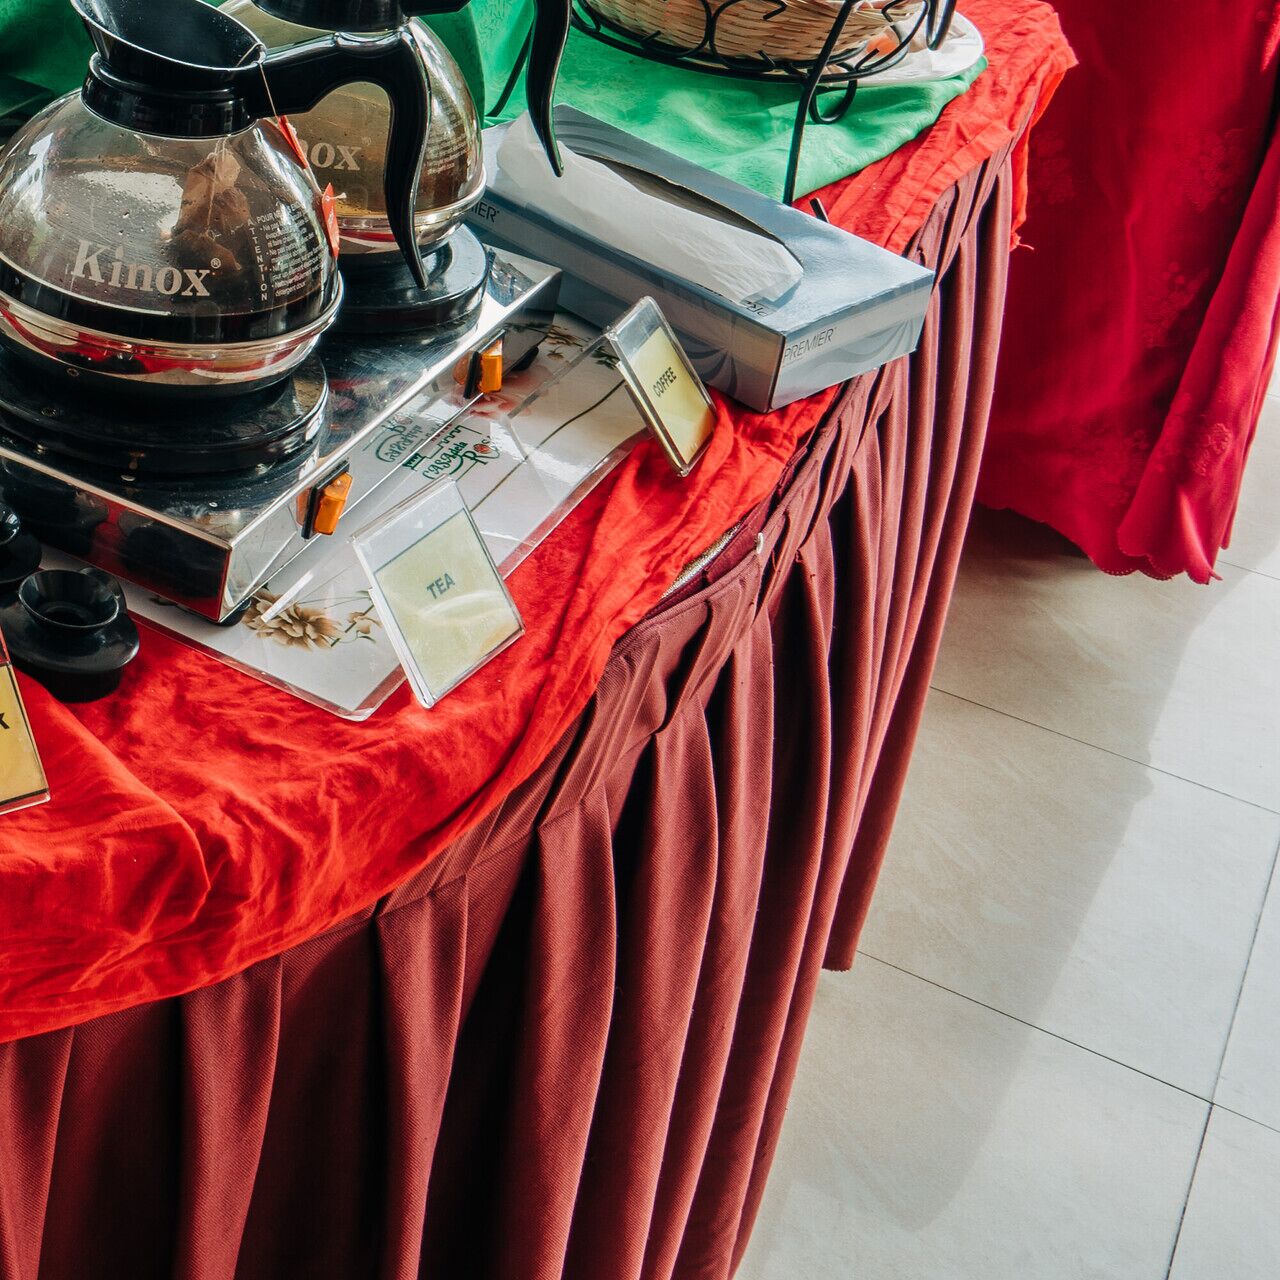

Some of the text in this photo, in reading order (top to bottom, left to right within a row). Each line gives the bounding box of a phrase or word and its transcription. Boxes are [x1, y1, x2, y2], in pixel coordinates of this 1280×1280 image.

[247, 219, 268, 301] ATTENTION
[783, 328, 835, 361] PREMIER
[653, 367, 677, 397] COFFEE
[426, 573, 456, 600] TEA
